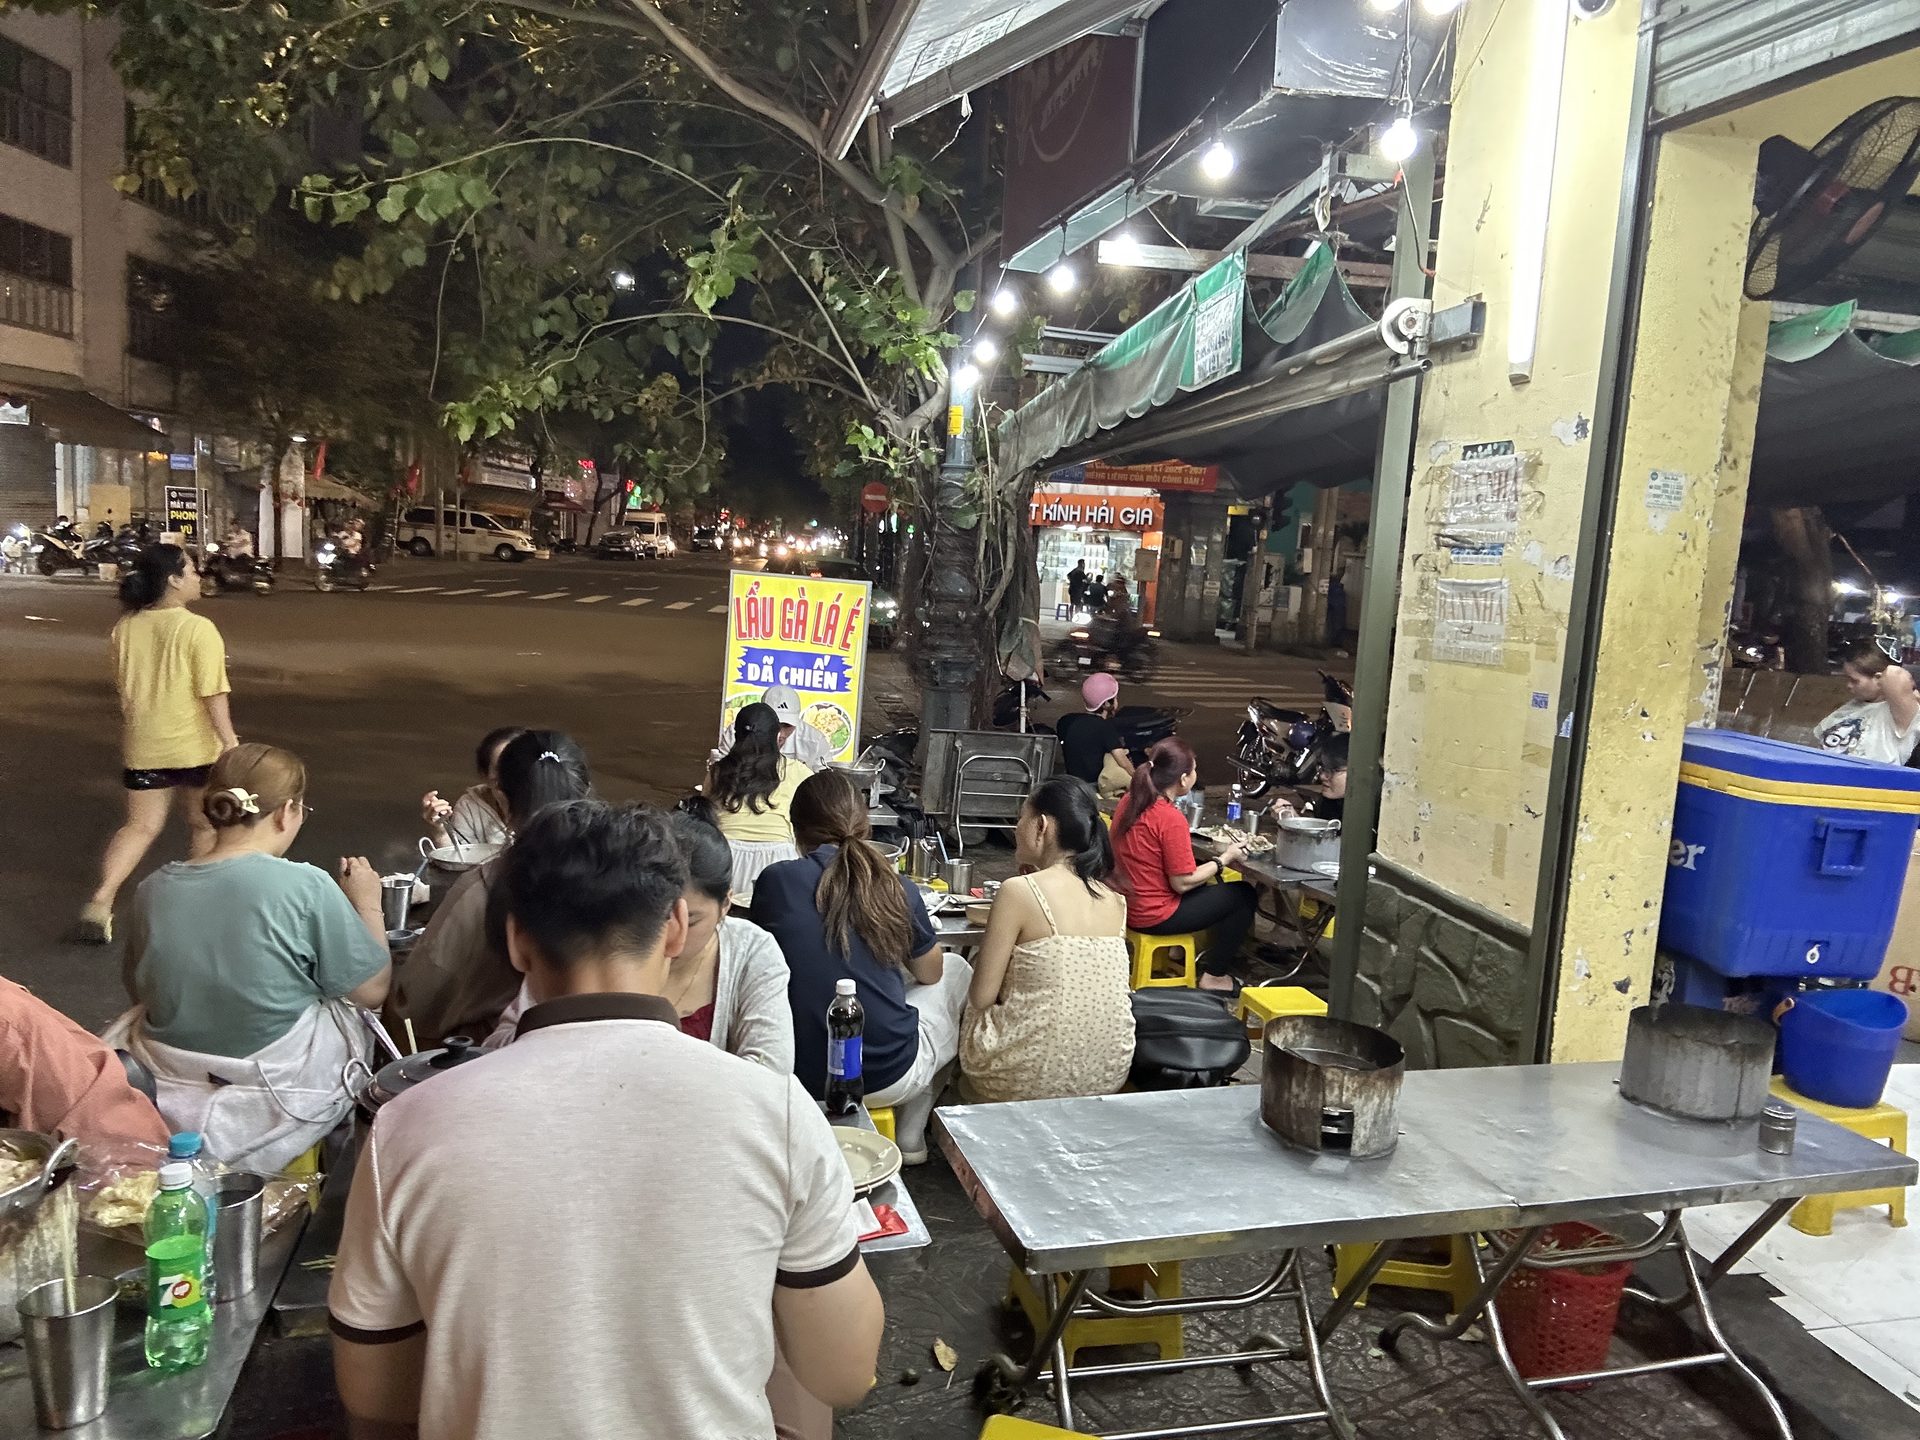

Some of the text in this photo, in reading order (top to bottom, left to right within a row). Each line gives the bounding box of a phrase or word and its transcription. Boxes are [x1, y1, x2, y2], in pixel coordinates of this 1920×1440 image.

[1042, 497, 1081, 522] KÍNH
[1085, 499, 1115, 524] HẢI
[1119, 507, 1153, 526] GIA
[733, 580, 864, 651] LẨU GÀ LÁ É
[747, 654, 838, 691] DÃ CHIẾN
